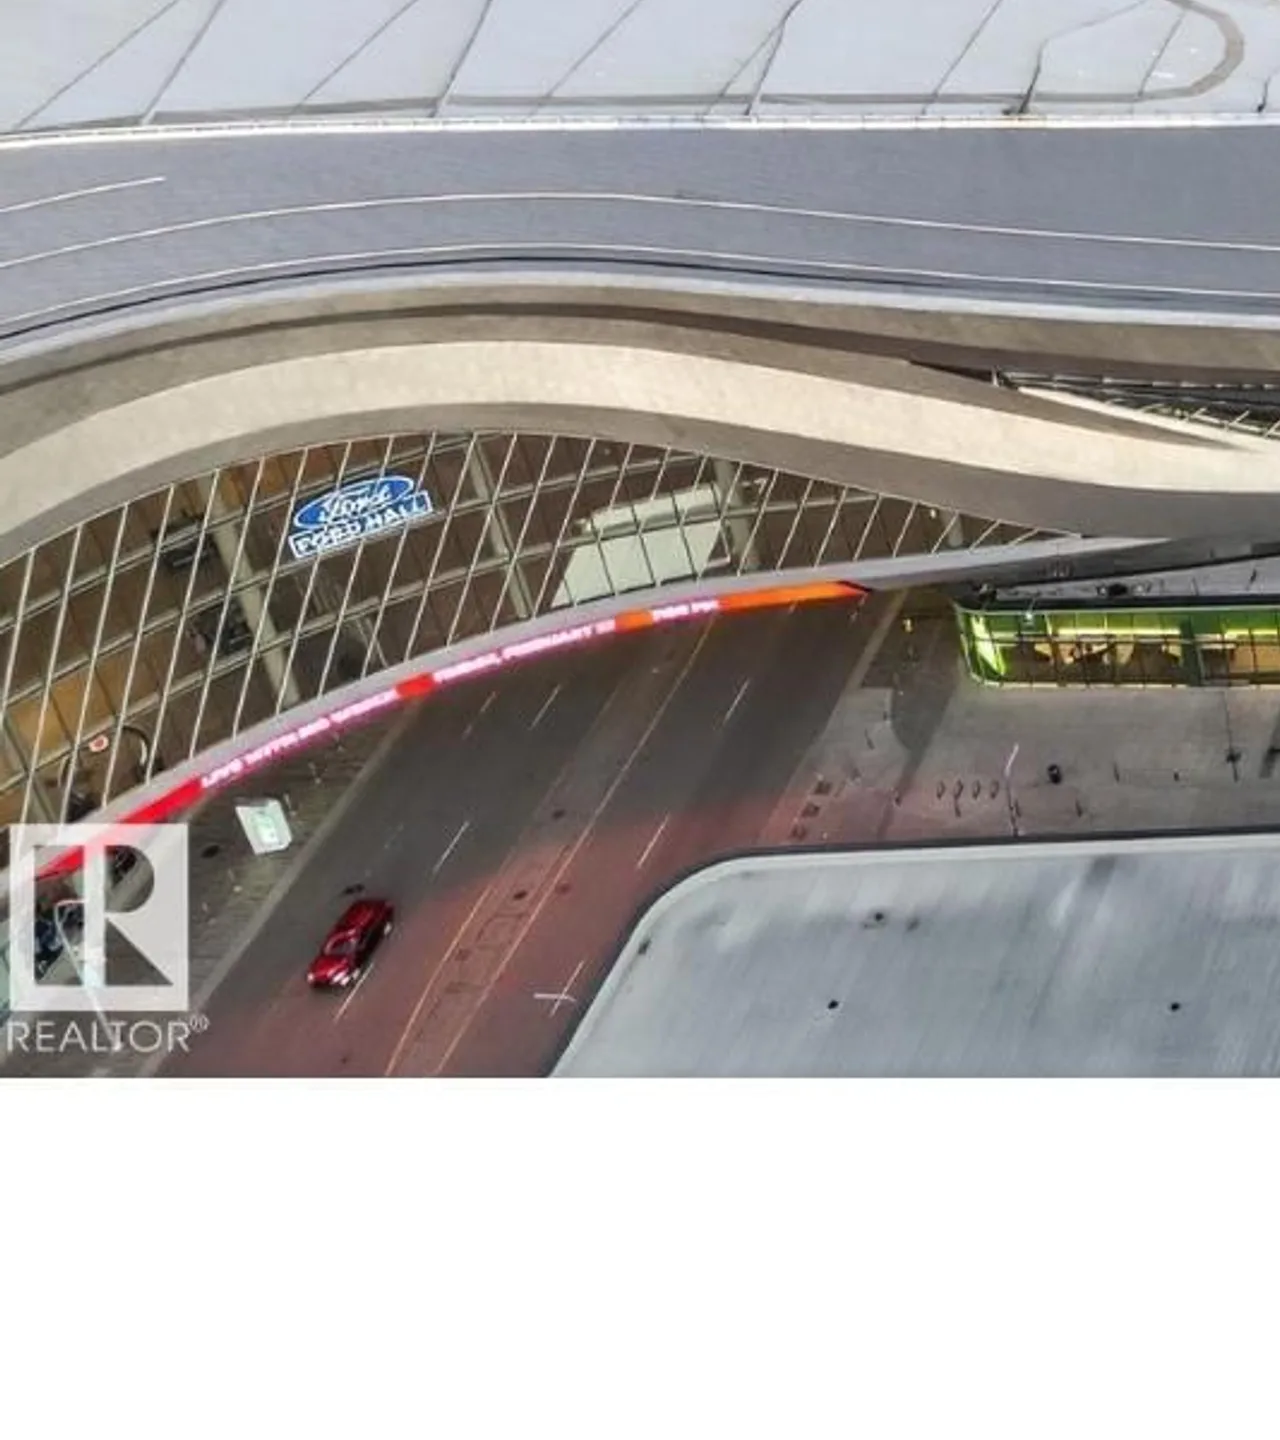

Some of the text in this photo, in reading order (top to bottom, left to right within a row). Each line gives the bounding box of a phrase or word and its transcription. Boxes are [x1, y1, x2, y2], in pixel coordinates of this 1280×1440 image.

[296, 494, 427, 553] FORD HALL
[318, 482, 393, 524] Ford
